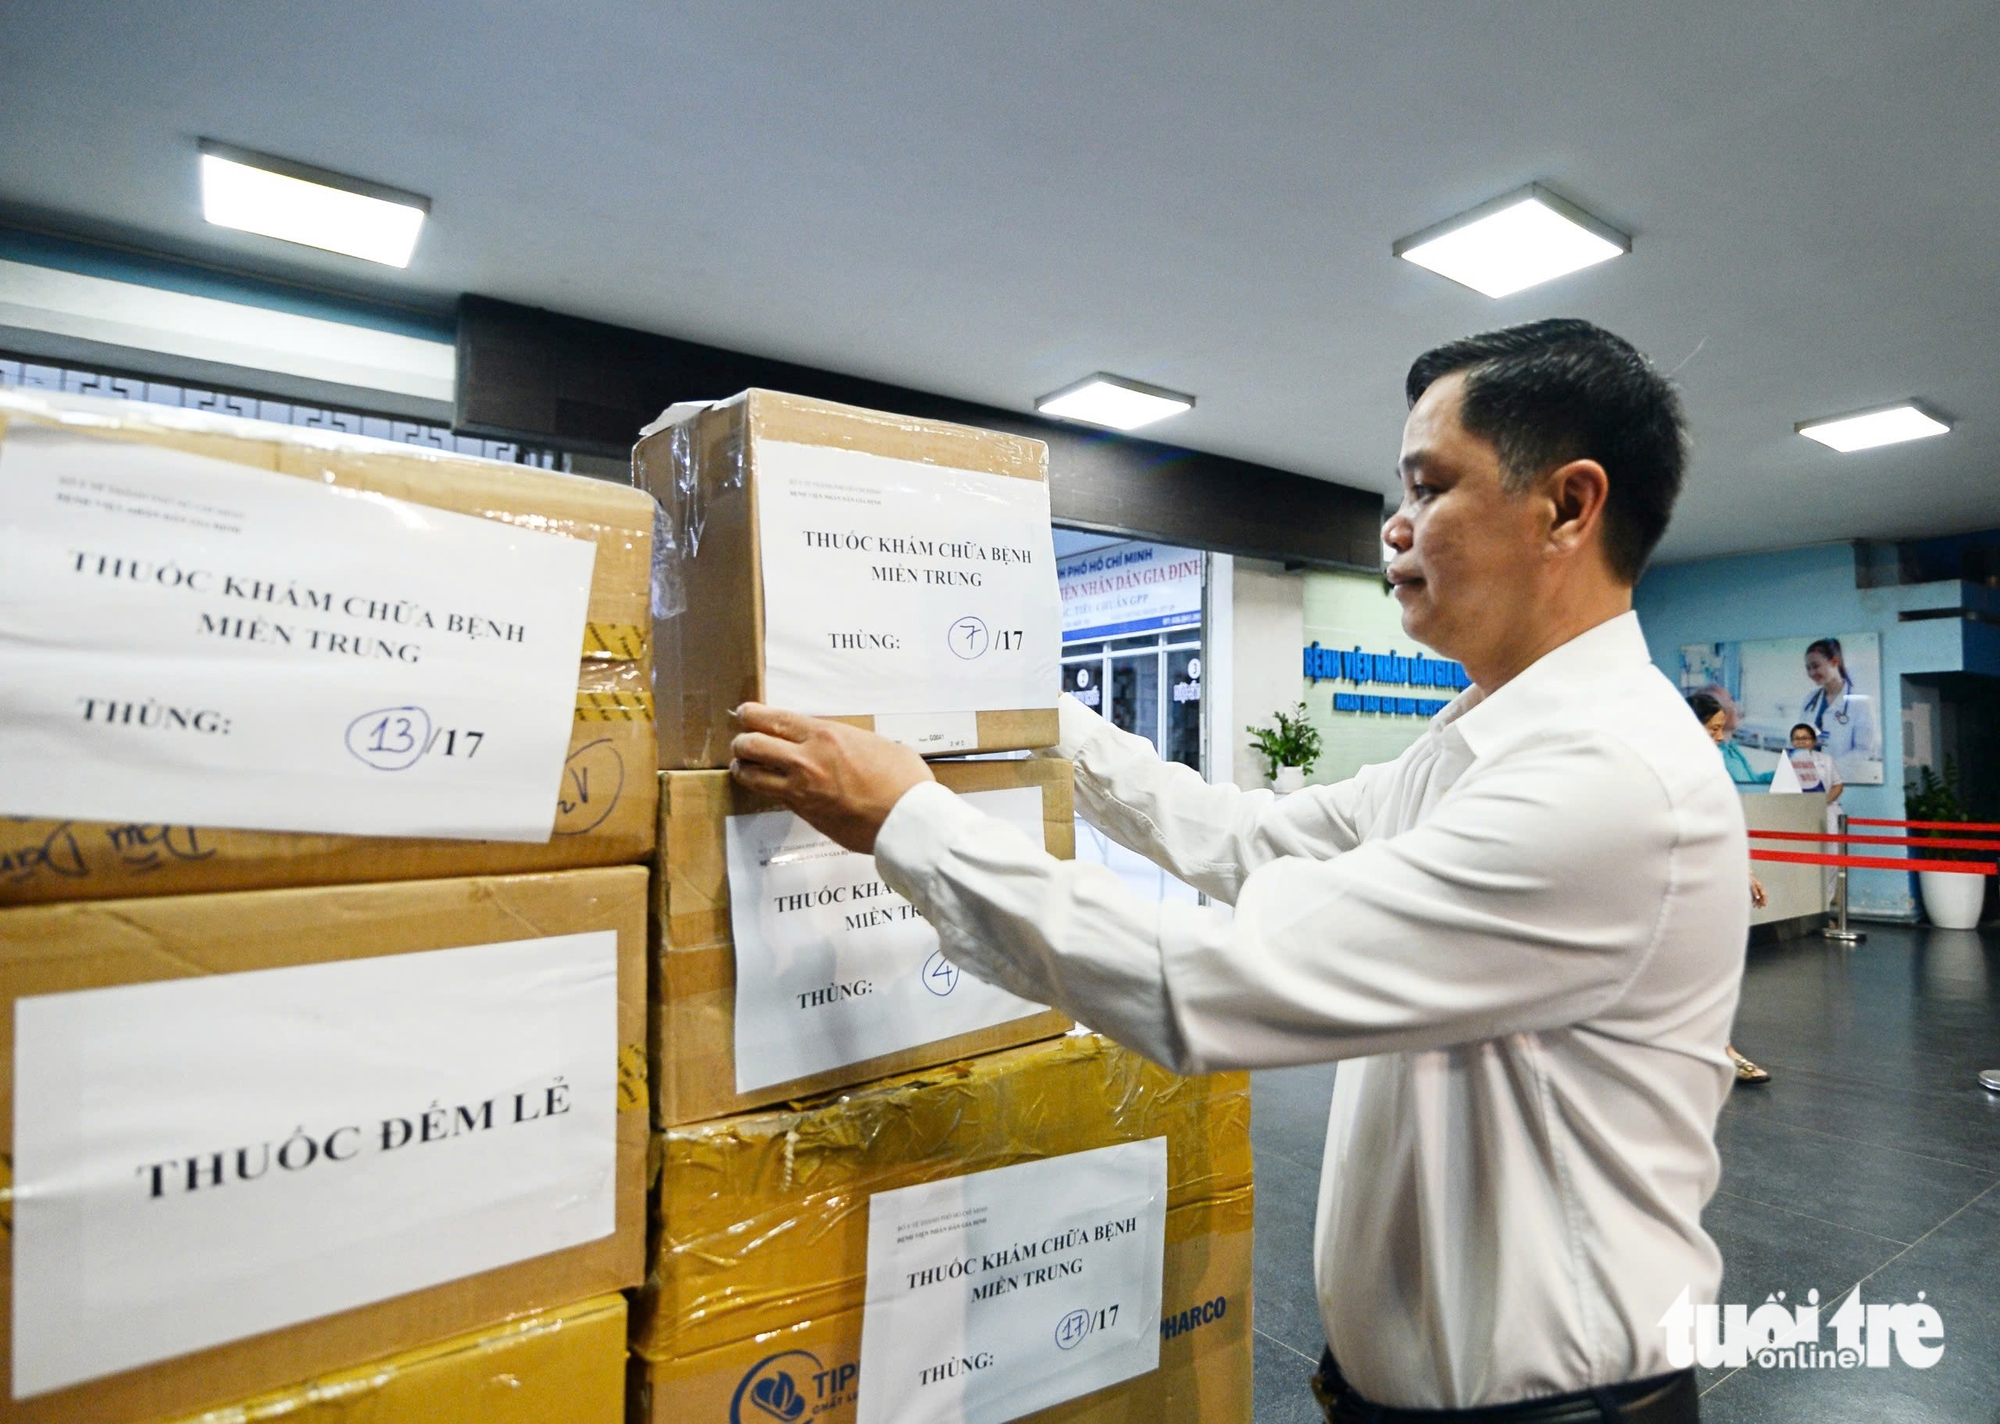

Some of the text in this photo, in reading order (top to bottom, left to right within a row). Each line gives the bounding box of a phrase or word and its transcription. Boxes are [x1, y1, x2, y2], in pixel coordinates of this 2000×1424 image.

[803, 530, 1032, 565] THUỐC KHÁM CHỮA BỆNH
[1067, 562, 1088, 577] PHỐ
[1089, 558, 1104, 573] HỒ
[1105, 551, 1123, 570] CHÍ
[1124, 548, 1154, 566] MINH
[871, 563, 983, 588] MIỀN TRUNG
[1080, 575, 1114, 600] NHÂN
[1115, 569, 1142, 592] DÂN
[1143, 566, 1167, 586] GIA
[70, 548, 526, 643] THUỐC KHÁM CHỮA BỆNH
[197, 612, 422, 664] MIỀN TRUNG
[828, 629, 901, 650] THÙNG:
[1303, 641, 1341, 684] BỆNH
[1342, 646, 1373, 687] VIỆN
[1373, 650, 1409, 685] NHÂN
[78, 696, 233, 736] THÙNG:
[774, 885, 846, 913] THUỐC
[845, 906, 893, 932] MIỀN
[797, 980, 873, 1010] THÙNG:
[137, 1075, 572, 1199] THUỐC ĐẾM LẺ
[907, 1216, 1138, 1290] THUỐC KHÁM CHỮA BỆNH
[971, 1258, 1084, 1303] MIỀN TRUNG
[1160, 1295, 1227, 1340] HARCO
[813, 1362, 860, 1398] TIP
[919, 1352, 995, 1387] THÙNG:
